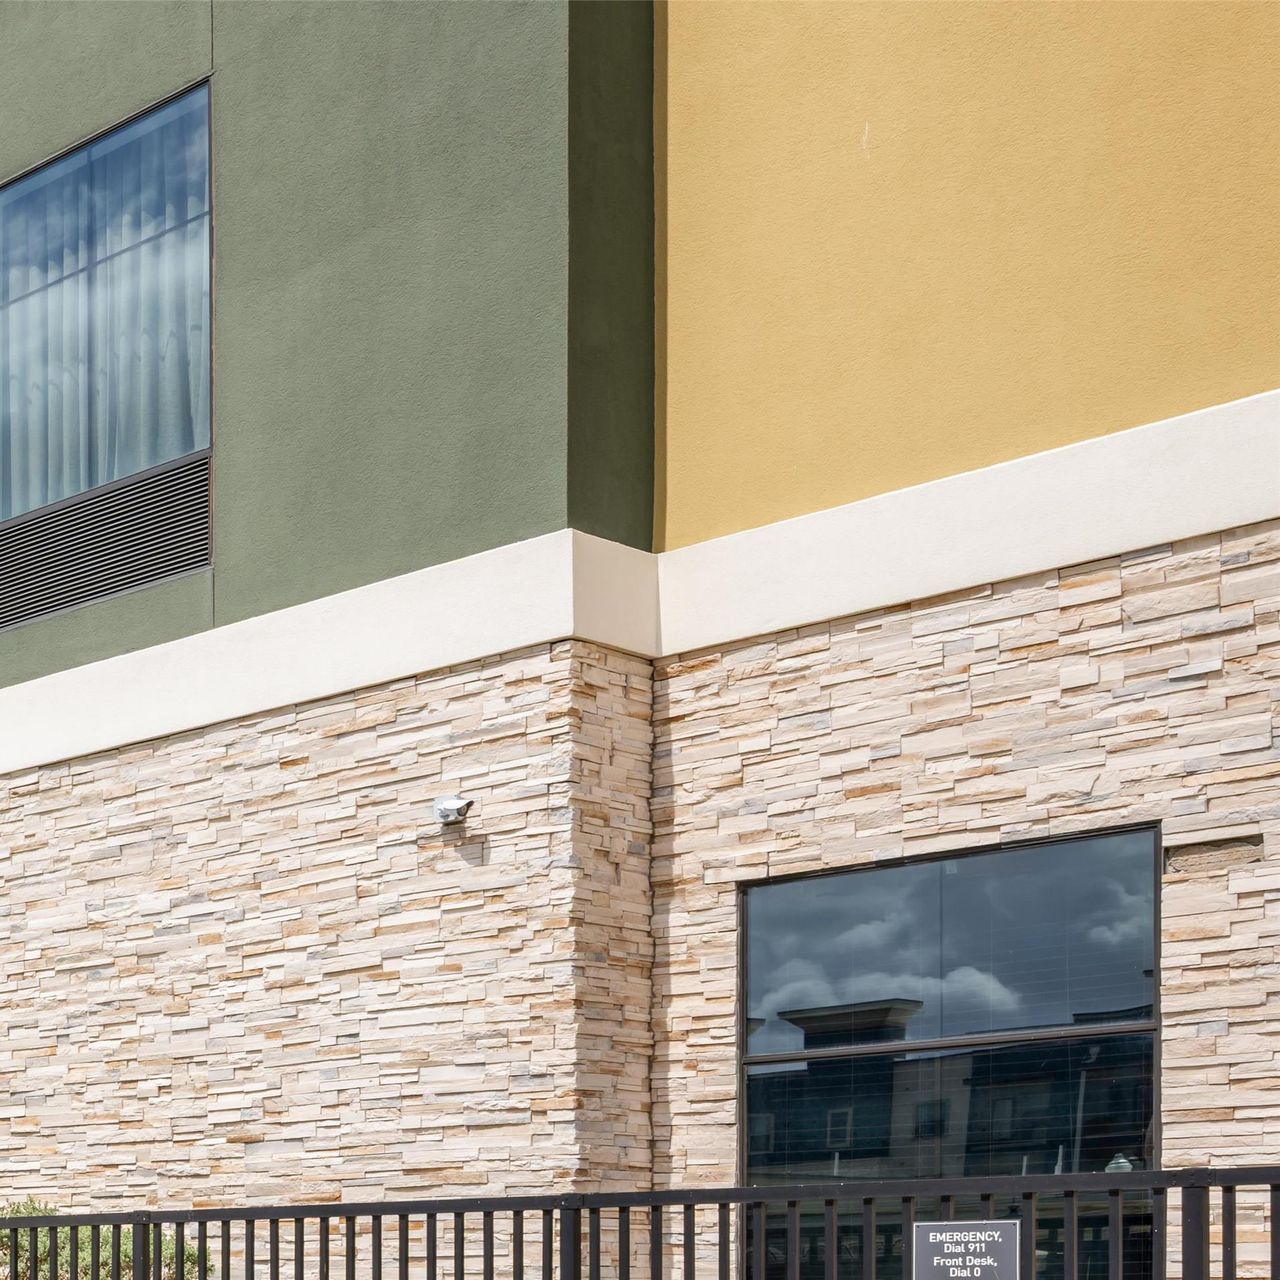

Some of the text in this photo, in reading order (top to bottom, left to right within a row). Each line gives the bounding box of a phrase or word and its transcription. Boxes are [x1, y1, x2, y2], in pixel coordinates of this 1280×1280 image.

[929, 1231, 1003, 1243] EMERGENCY,
[944, 1243, 986, 1253] Dial 911
[933, 1256, 998, 1267] Front Desk,
[949, 1267, 981, 1277] Dial 0
